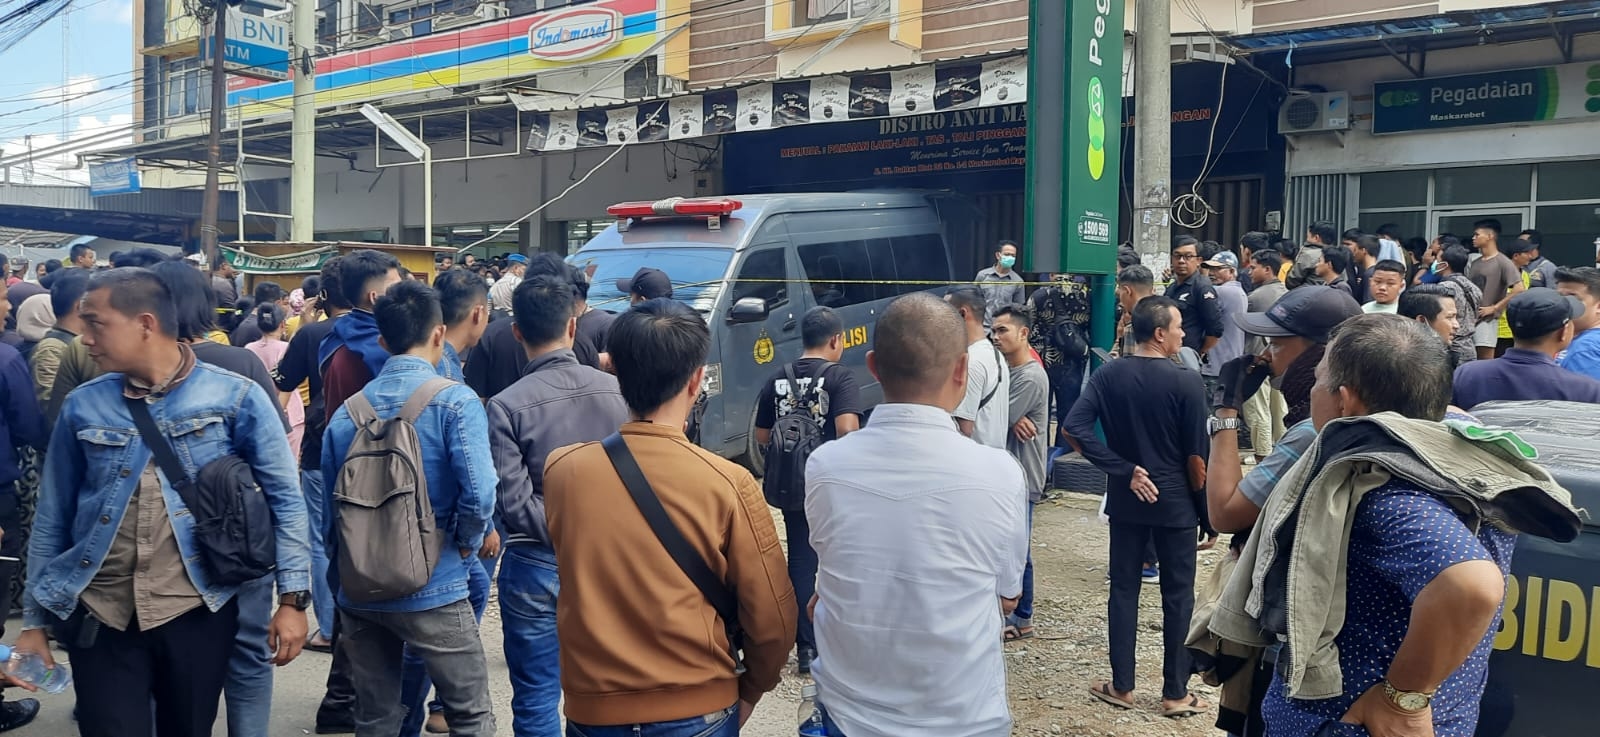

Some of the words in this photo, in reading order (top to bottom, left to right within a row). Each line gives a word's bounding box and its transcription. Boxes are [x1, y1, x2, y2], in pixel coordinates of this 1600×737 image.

[243, 17, 284, 46] BNI
[534, 18, 609, 48] Indomaret
[1430, 81, 1533, 106] Pegadaian
[871, 136, 919, 150] LAKI-LAKI
[926, 134, 945, 146] TAS
[952, 131, 974, 143] TALI
[1171, 108, 1211, 122] NGAN
[879, 111, 945, 134] DISTRO
[950, 106, 996, 128] ANTI
[1430, 111, 1485, 121] Maskarebet
[951, 147, 980, 158] Service
[842, 325, 867, 348] LISI
